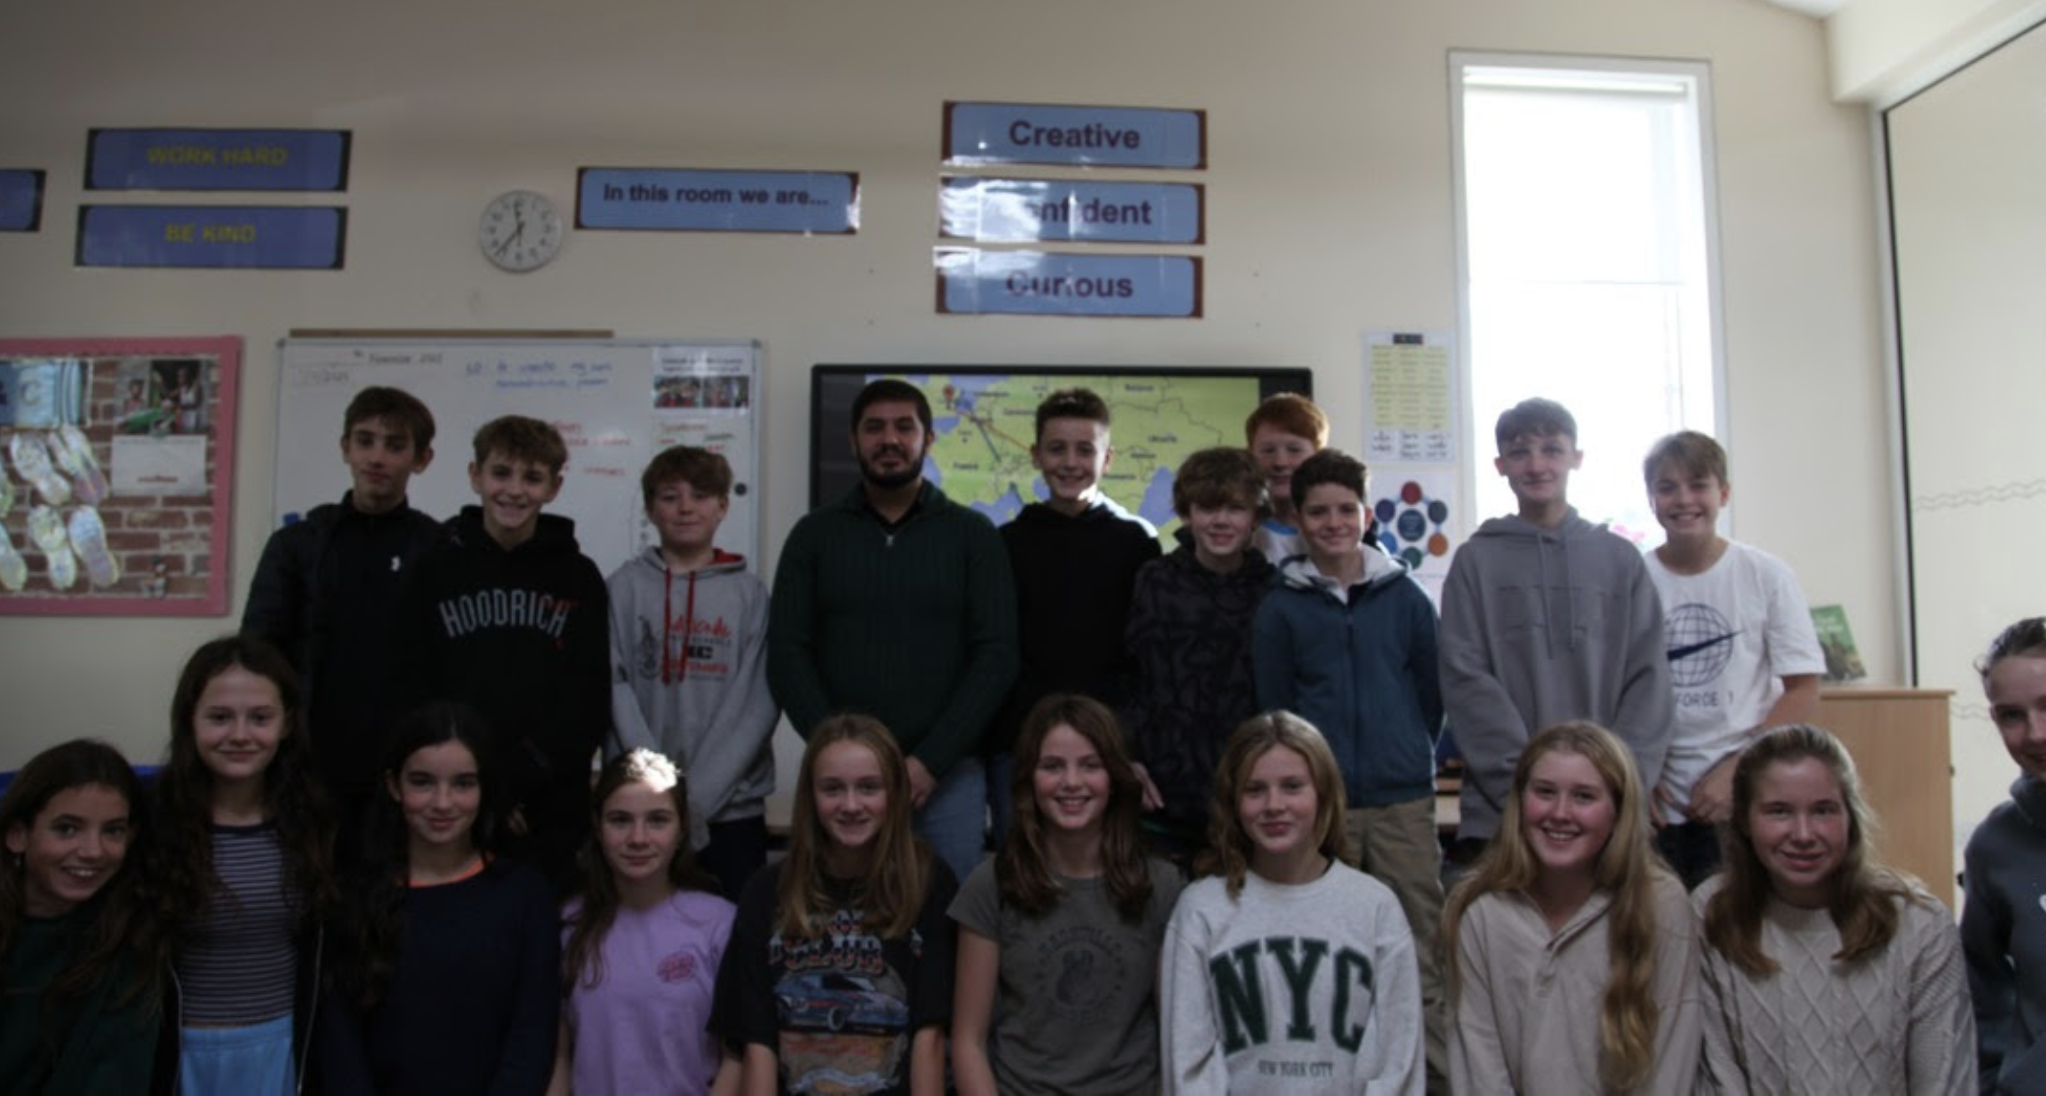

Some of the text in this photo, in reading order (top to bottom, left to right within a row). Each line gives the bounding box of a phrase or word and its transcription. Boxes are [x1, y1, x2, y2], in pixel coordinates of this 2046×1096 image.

[1009, 121, 1140, 149] Creative
[147, 146, 288, 167] WORK HARD
[603, 183, 828, 205] In this room we are...
[164, 223, 256, 243] BE KIND
[438, 588, 571, 638] HOODRICH
[1208, 936, 1374, 1058] NYC
[1258, 1060, 1334, 1078] NEW YORK CITY
